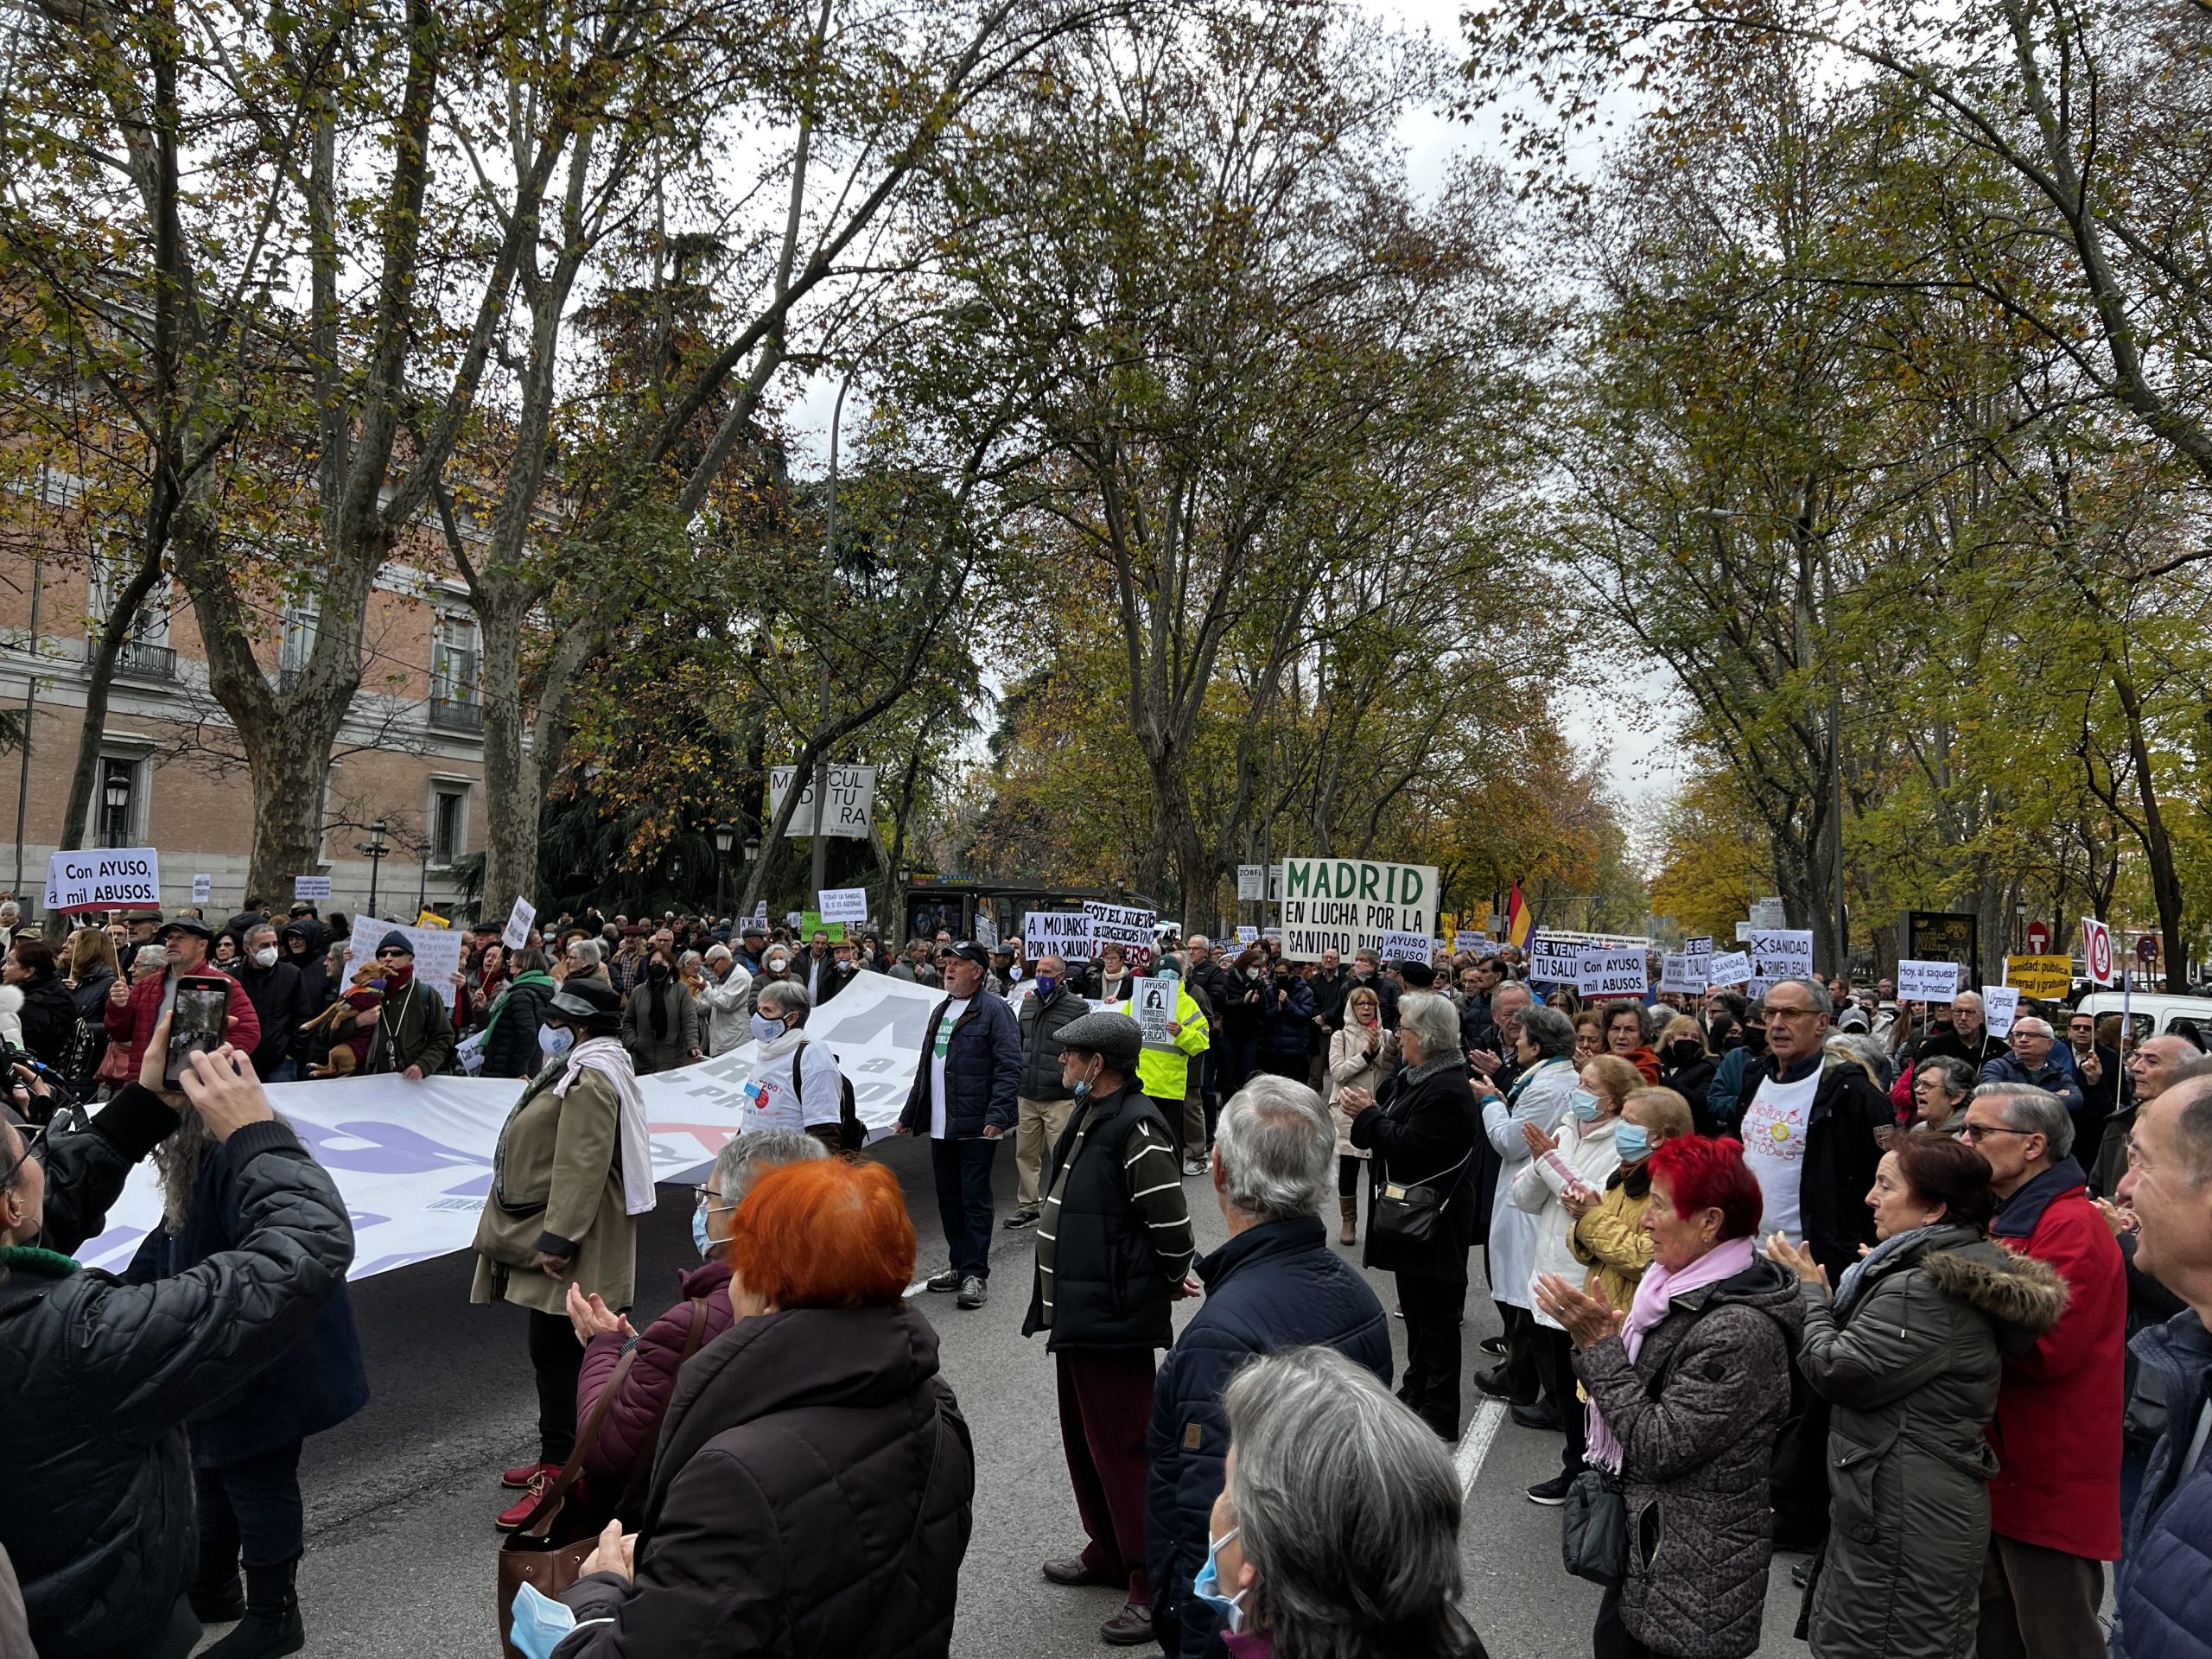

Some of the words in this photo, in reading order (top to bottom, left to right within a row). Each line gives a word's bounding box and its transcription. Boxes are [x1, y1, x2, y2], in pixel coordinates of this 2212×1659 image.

[66, 864, 92, 880] Con
[99, 861, 151, 878] AYUSO,
[1287, 861, 1424, 905] MADRID
[67, 887, 87, 904] mil
[94, 884, 155, 901] ABUSOS.
[1084, 905, 1108, 921] SOY
[1107, 909, 1122, 924] EL
[1122, 911, 1155, 929] NUEVO
[1286, 901, 1305, 923] EN
[1312, 902, 1358, 926] LUCHA
[1367, 905, 1395, 930] POR
[1402, 909, 1422, 932] LA
[1028, 917, 1036, 936] A
[1028, 941, 1045, 957] POR
[1062, 939, 1091, 958] SALUD!
[1227, 944, 1248, 953] VENDE
[1289, 931, 1350, 955] SANIDAD
[1385, 936, 1428, 950] ¡AYUSO,
[1535, 941, 1548, 955] SE
[1769, 939, 1810, 957] SANIDAD,
[1385, 949, 1427, 962] ABUSO!
[1536, 958, 1548, 976] TU
[1551, 959, 1578, 978] SALU
[1584, 961, 1602, 973] Con
[1606, 958, 1642, 972] AYUSO,
[1764, 961, 1788, 975] CRIMEN
[1789, 961, 1811, 976] LEGAL!
[1900, 965, 1916, 978] Hoy,
[1918, 966, 1924, 976] al
[1927, 969, 1956, 980] saquear
[2008, 960, 2040, 973] sanidad:
[2042, 961, 2070, 976] pública,
[1144, 982, 1167, 990] AYUSO
[1584, 979, 1598, 992] mil
[1602, 977, 1644, 991] ABUSOS.
[2036, 982, 2040, 993] y
[937, 1025, 953, 1034] ANID
